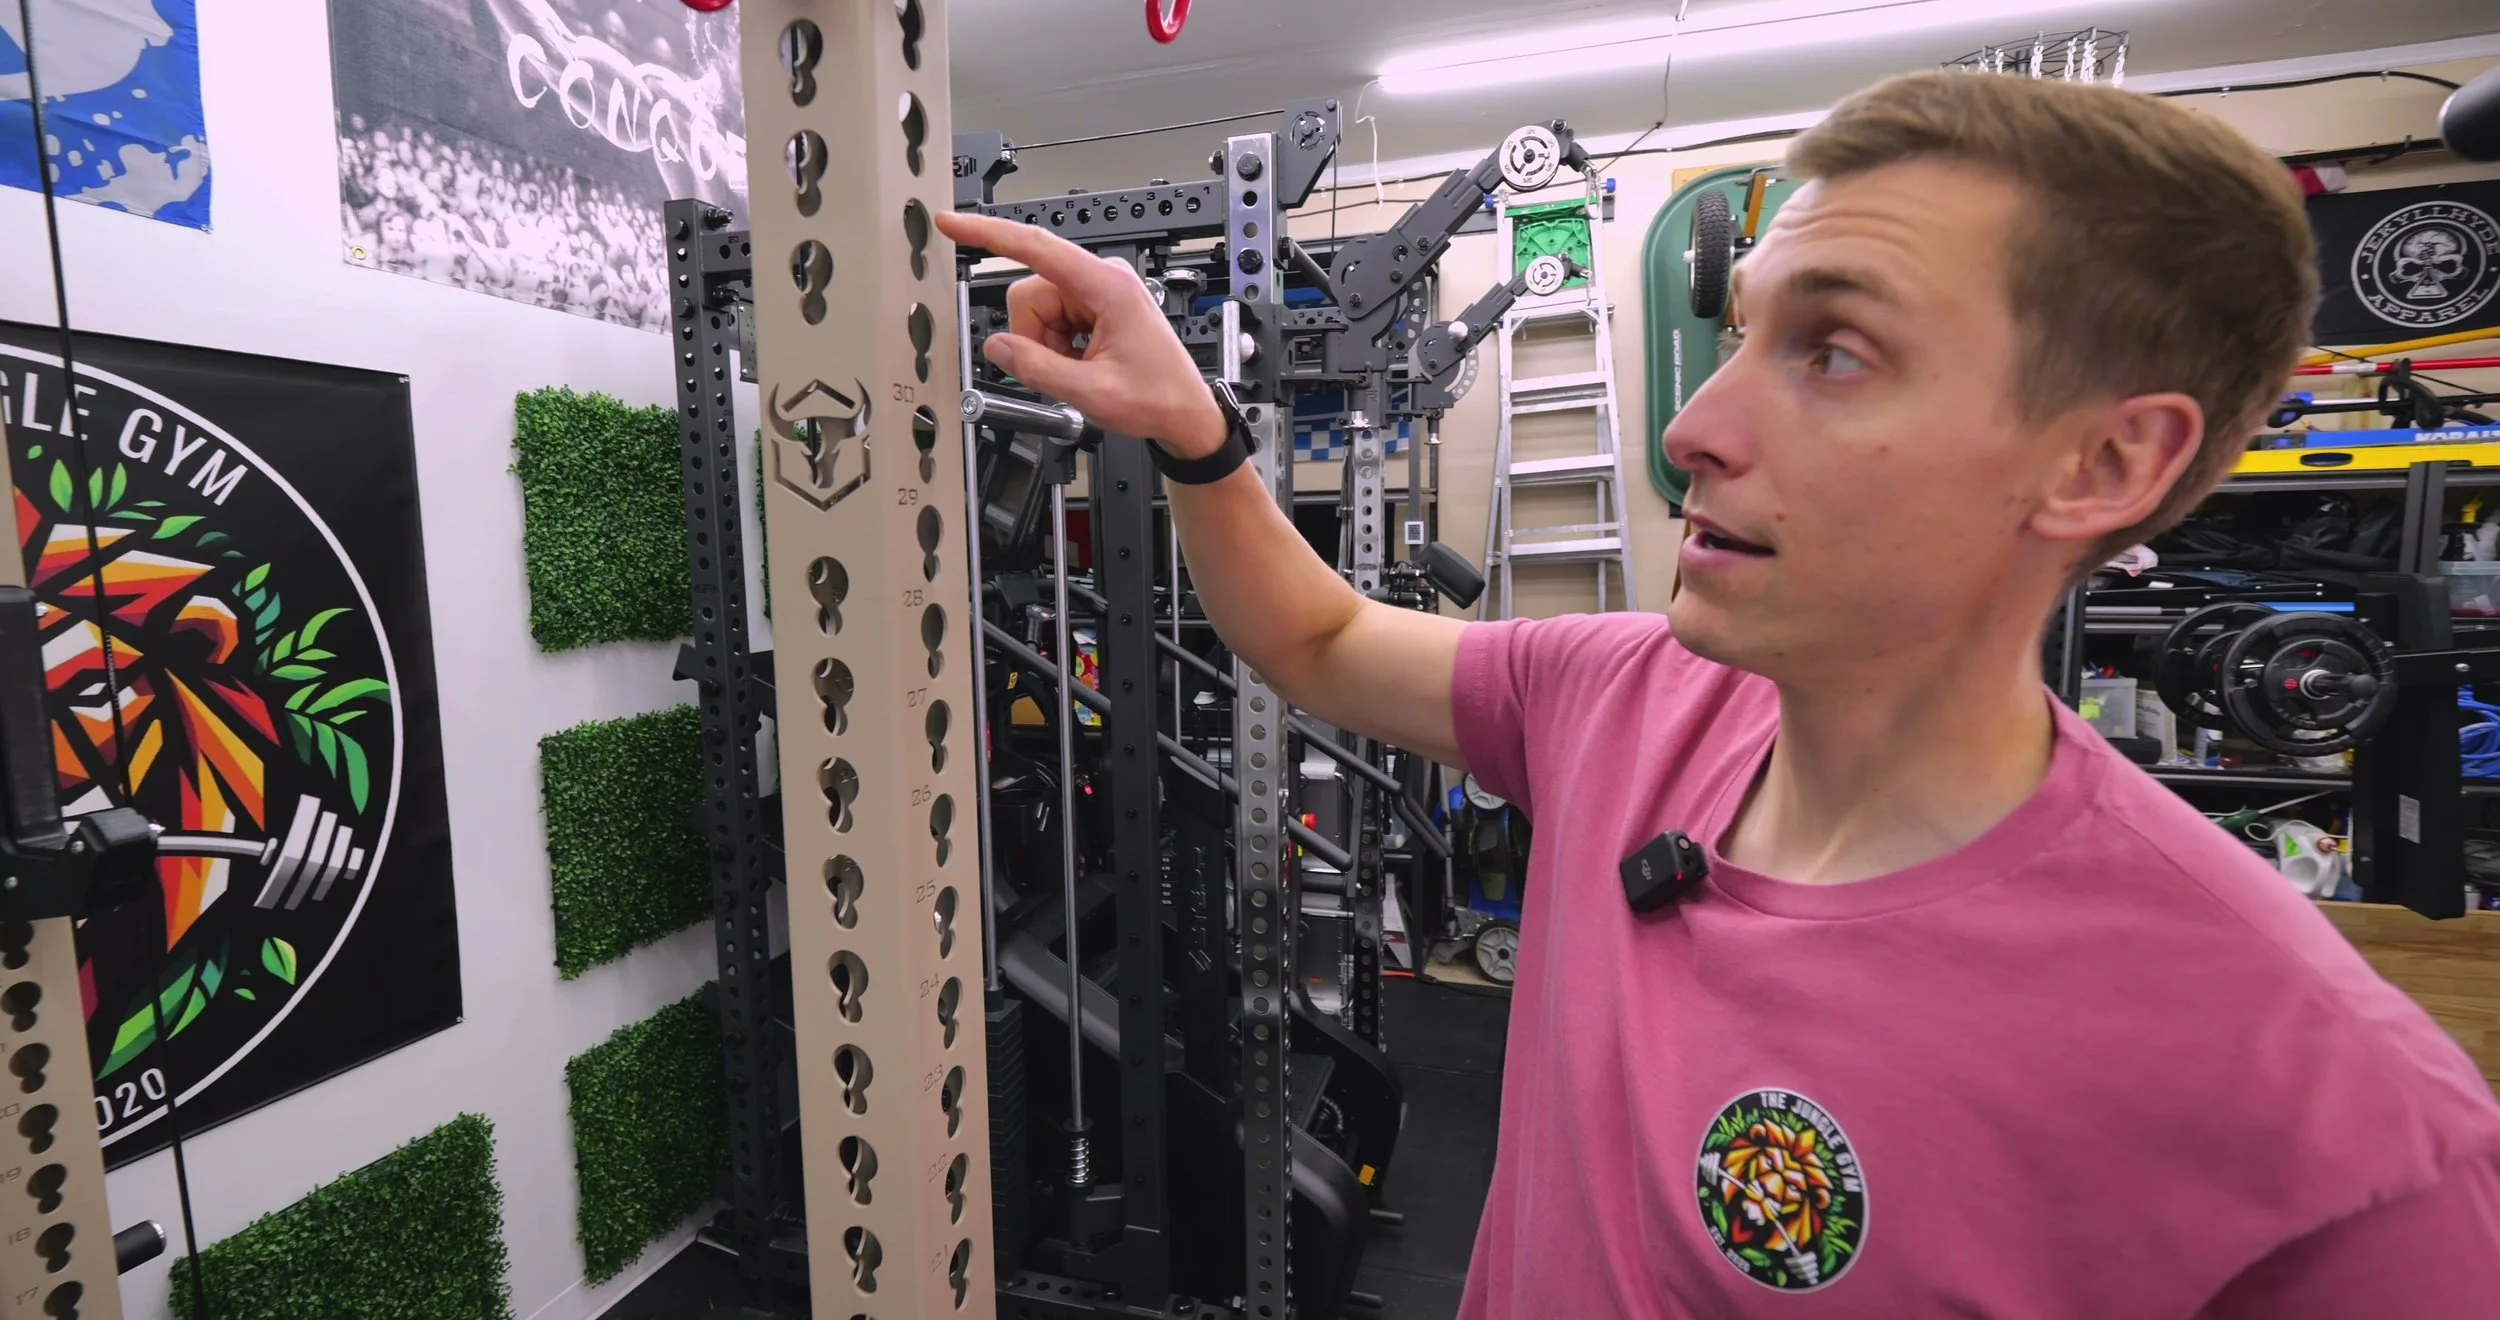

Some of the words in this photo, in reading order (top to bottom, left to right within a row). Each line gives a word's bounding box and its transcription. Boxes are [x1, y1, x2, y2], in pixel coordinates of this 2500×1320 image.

[1040, 204, 1048, 212] 7
[1093, 198, 1101, 206] 5
[1147, 192, 1155, 201] 3
[1175, 189, 1183, 198] 2
[1203, 186, 1210, 194] 1
[2361, 207, 2500, 263] JEKYLLHYDE
[2367, 289, 2490, 322] APPAREL
[893, 383, 915, 403] 30
[118, 407, 249, 506] GYM
[898, 488, 918, 505] 29
[903, 590, 924, 607] 28
[907, 688, 927, 708] 27
[911, 785, 932, 807] 26
[915, 881, 936, 903] 25
[919, 972, 939, 999] 24
[924, 1064, 944, 1091] 23
[94, 1068, 167, 1131] 020
[1760, 1092, 1788, 1109] THE
[1790, 1099, 1844, 1149] JUNGLE
[1834, 1152, 1862, 1192] GYM
[928, 1153, 948, 1183] 22
[9, 1227, 31, 1245] 18
[931, 1244, 948, 1272] 21
[16, 1286, 39, 1305] 17
